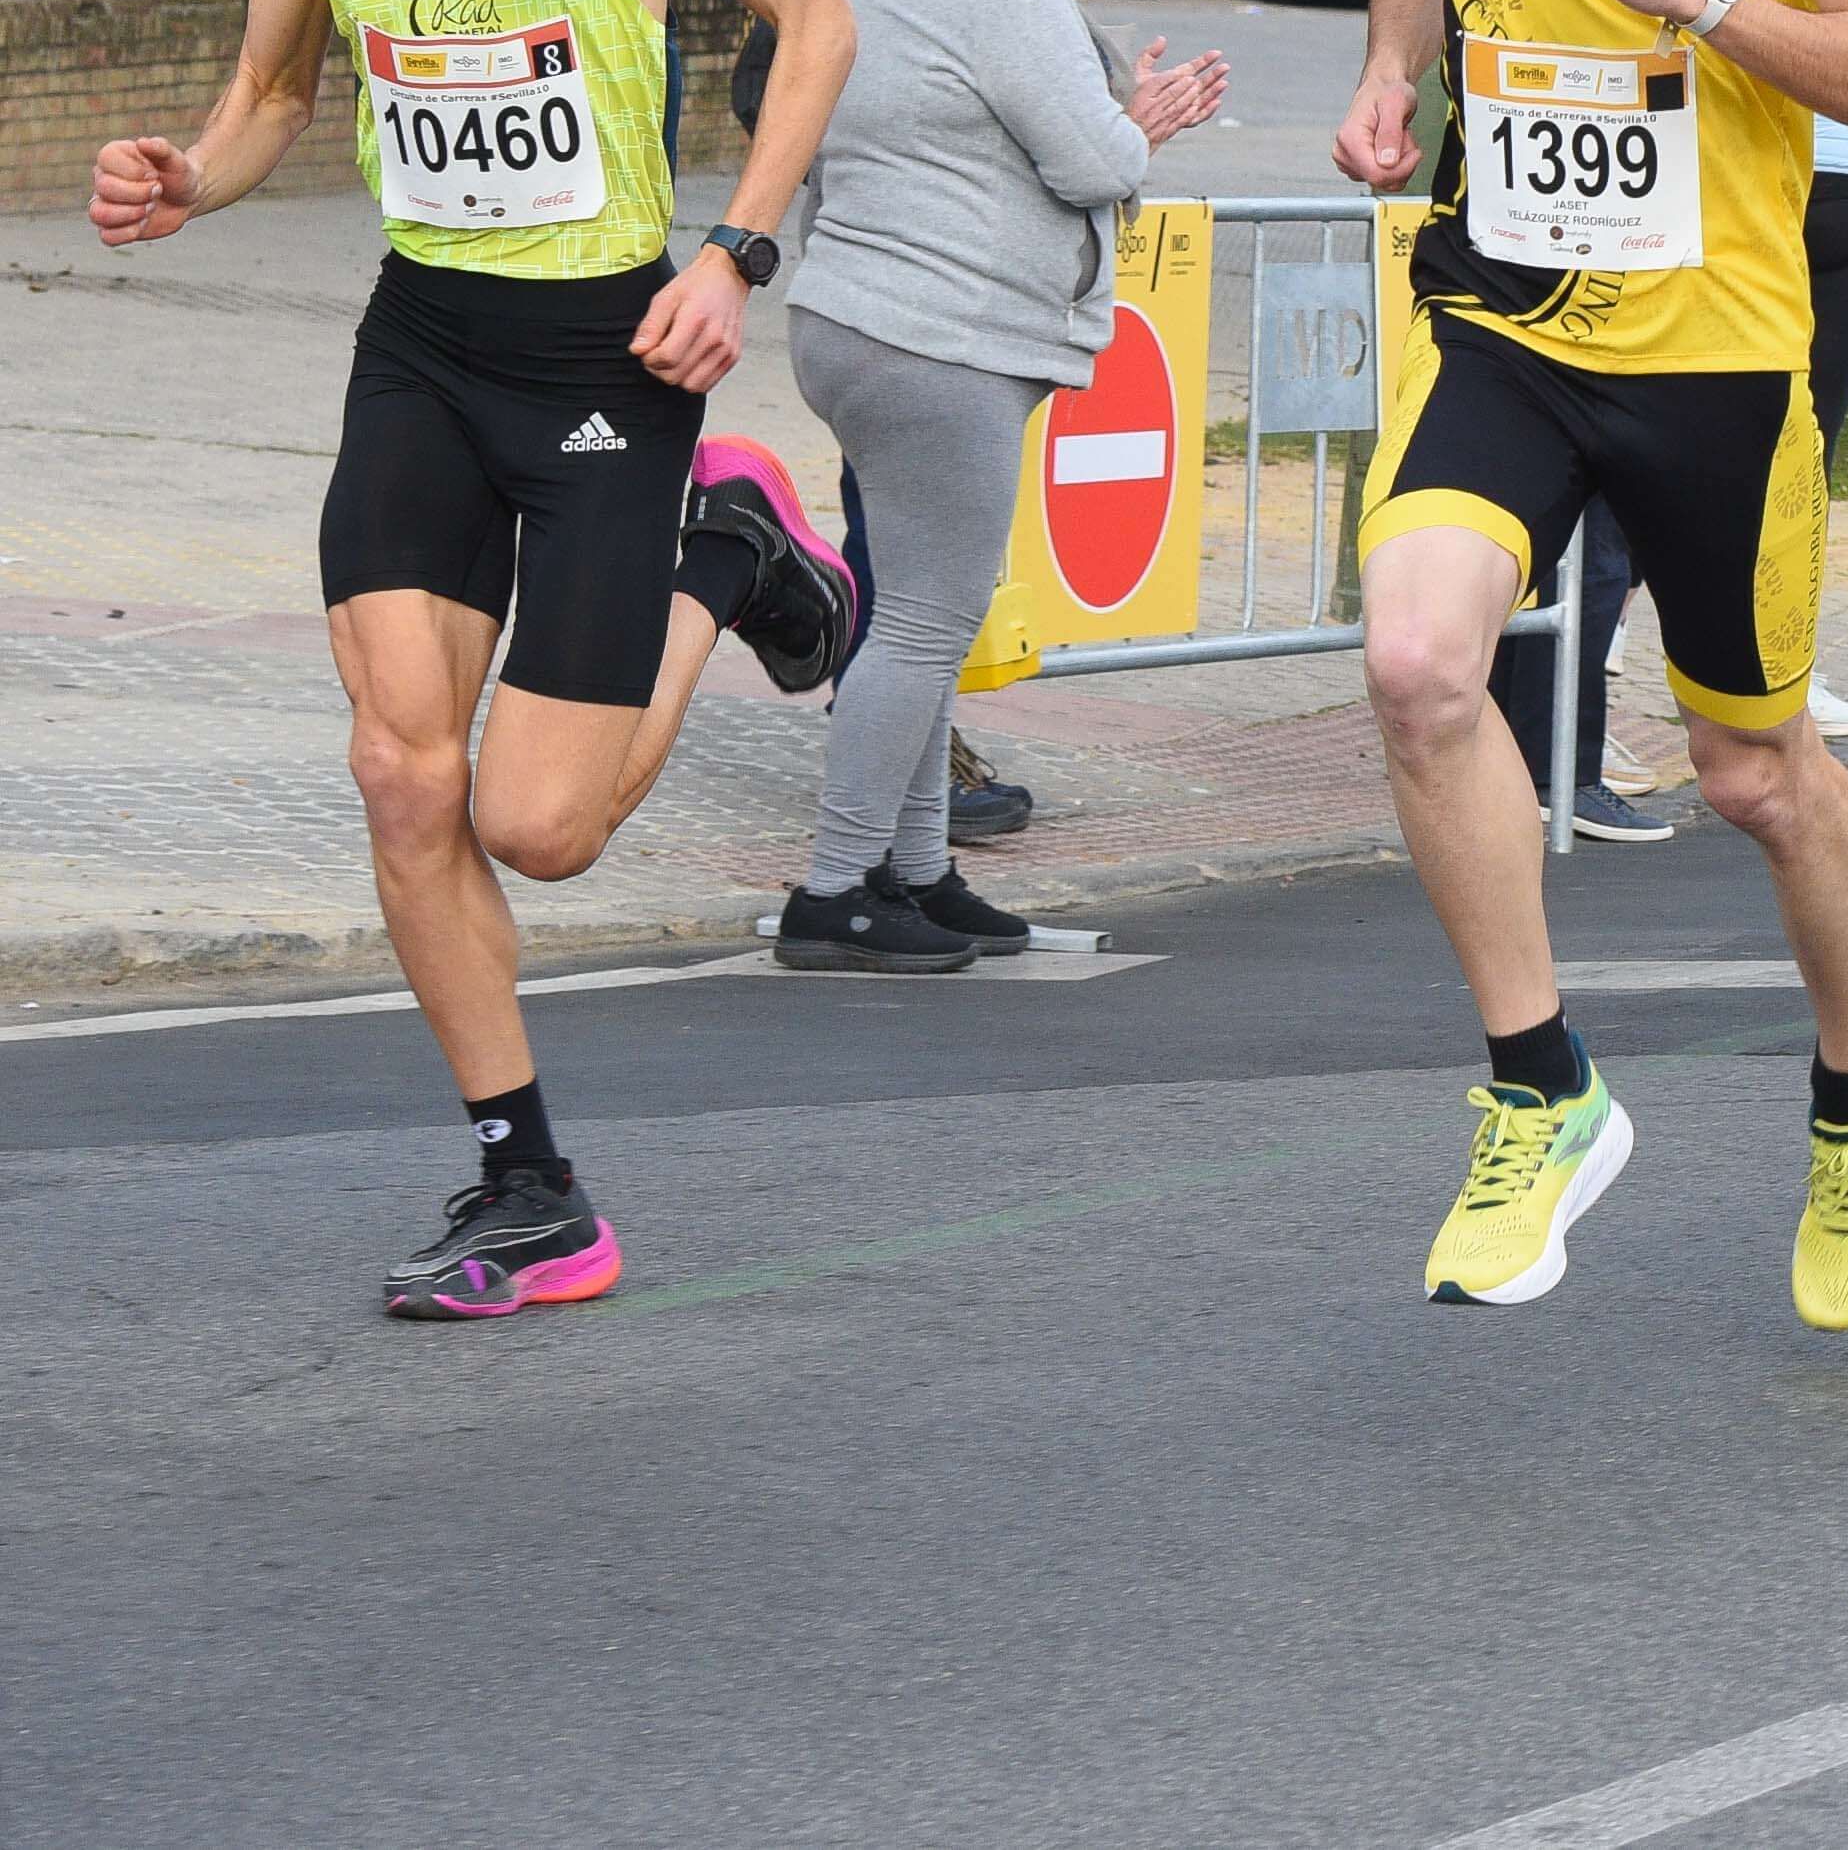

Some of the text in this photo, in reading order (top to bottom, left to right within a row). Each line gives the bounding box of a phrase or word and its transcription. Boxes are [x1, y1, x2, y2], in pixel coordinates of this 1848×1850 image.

[543, 44, 562, 76] 8
[390, 84, 550, 103] Circuito de Carreras #Sevilla10
[1488, 103, 1657, 124] Circuito de Carreras #Sevilla10
[384, 96, 581, 174] 10460
[1492, 116, 1658, 198] 1399
[1552, 201, 1589, 211] JASET
[1507, 208, 1642, 227] VELÁZQUEZ RODRÍGUEZ
[560, 436, 628, 452] adidas
[1807, 525, 1822, 608] ALGABA
